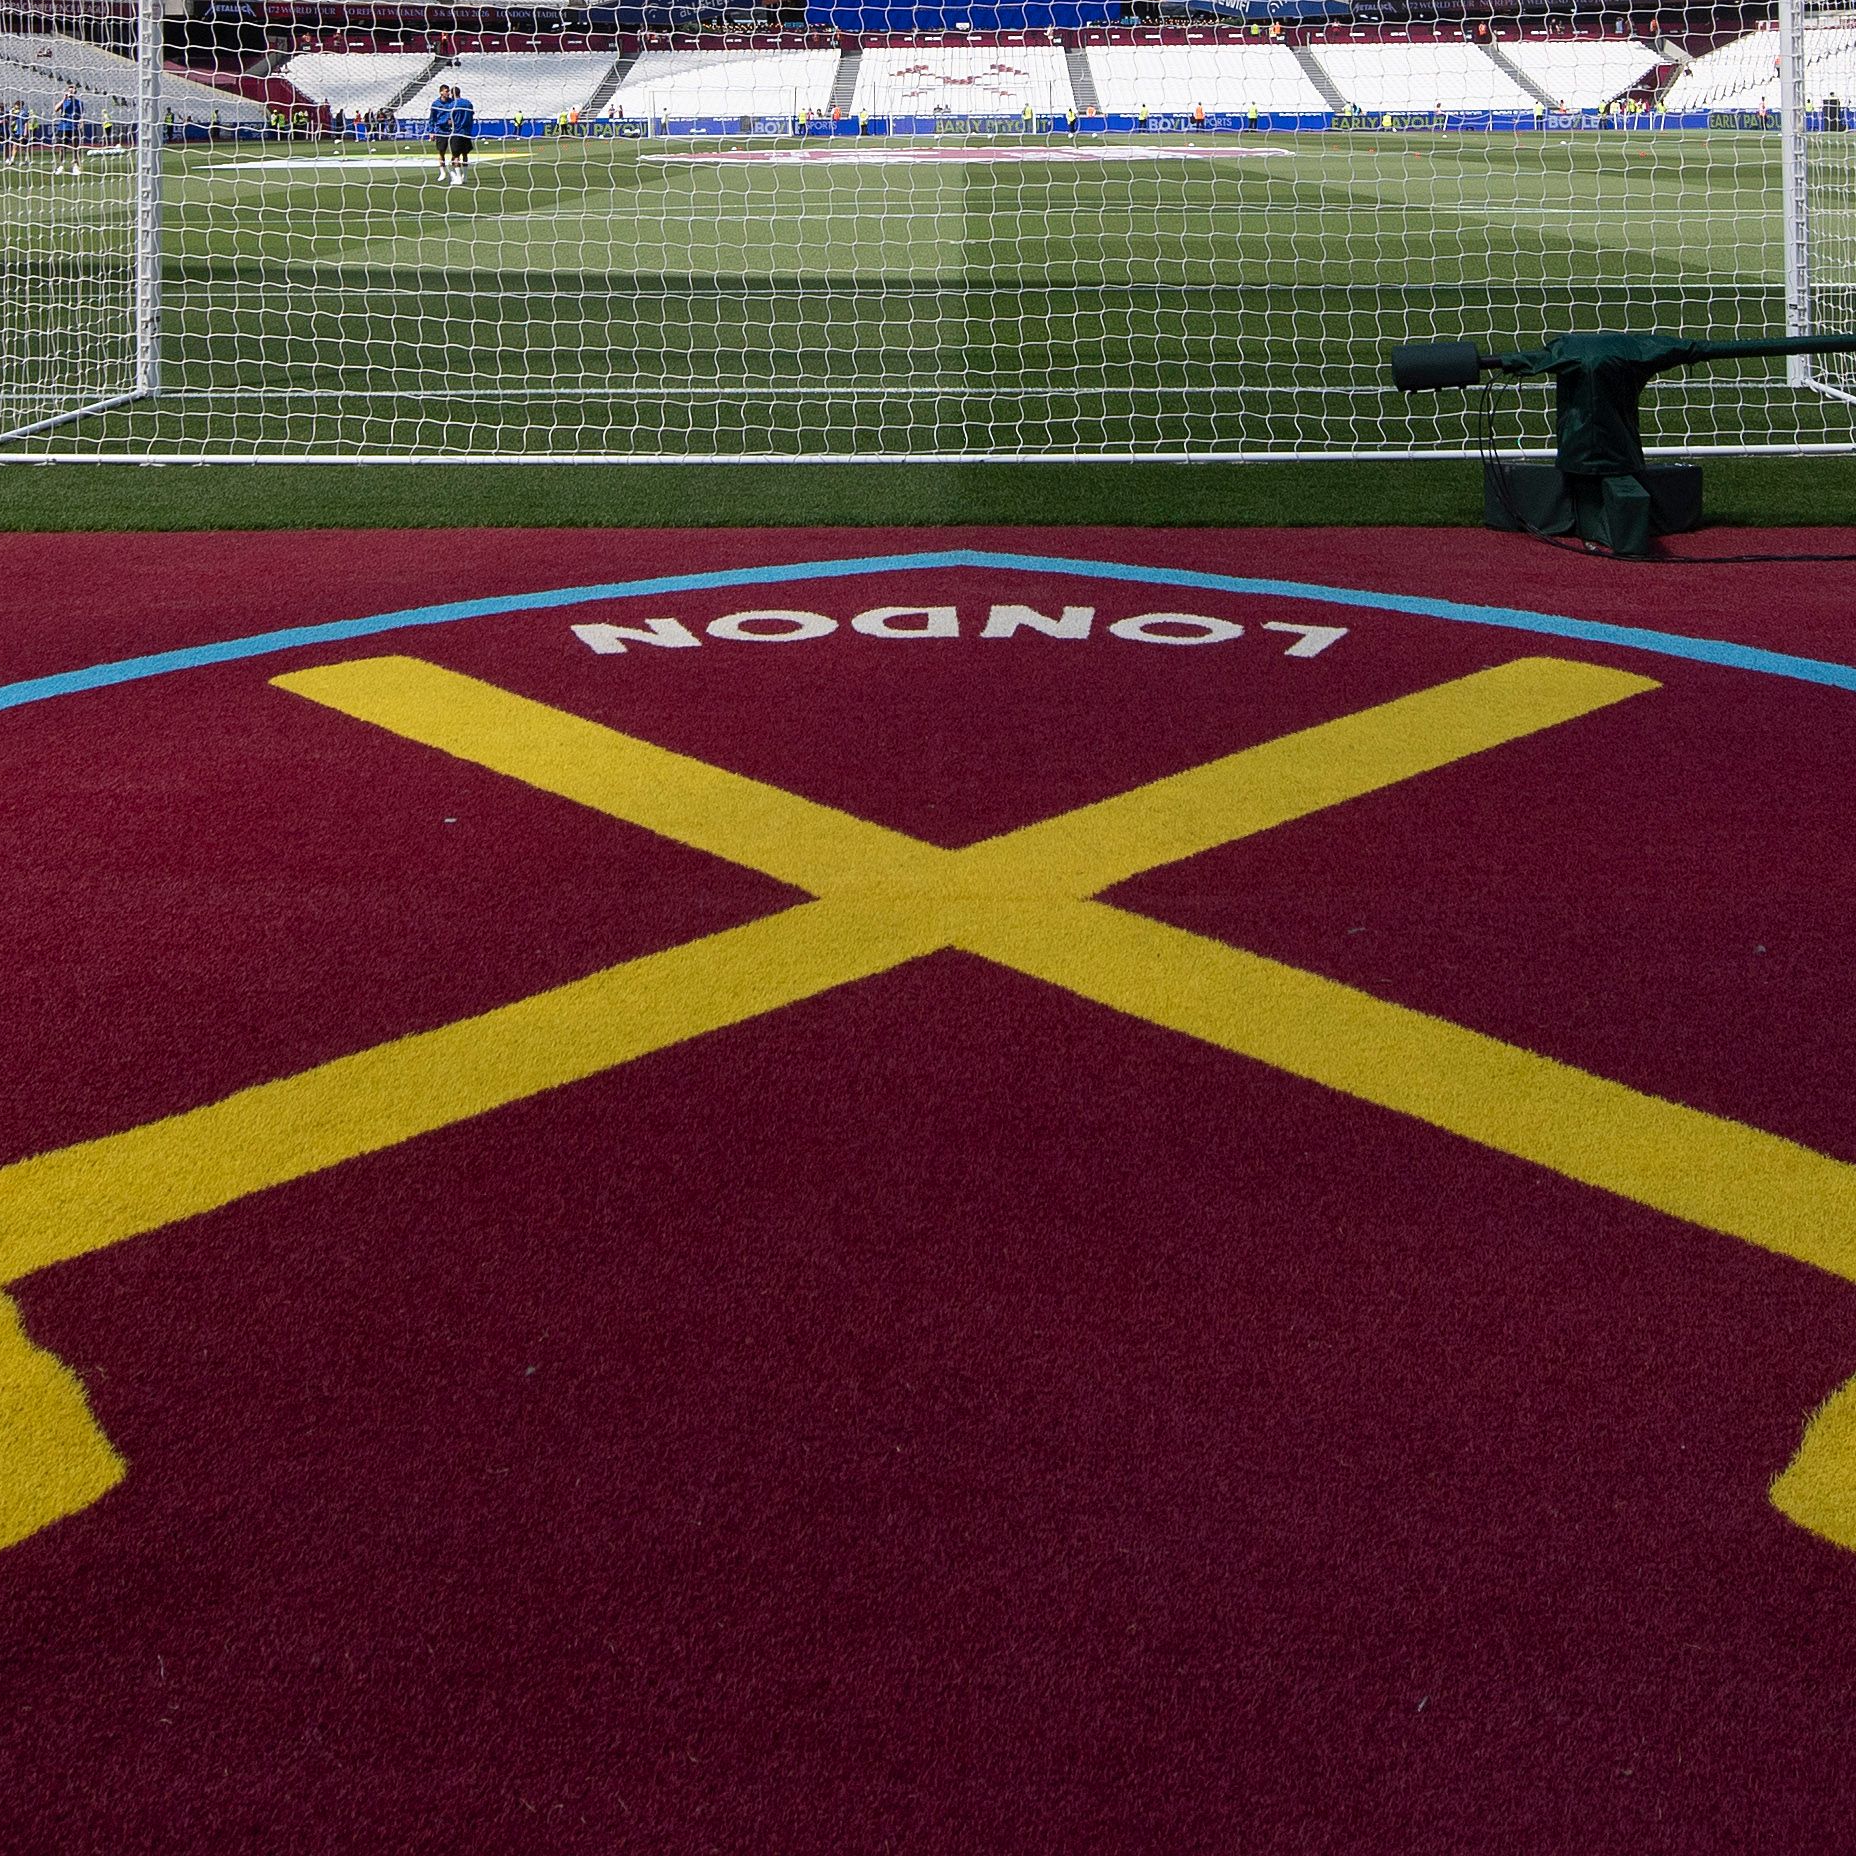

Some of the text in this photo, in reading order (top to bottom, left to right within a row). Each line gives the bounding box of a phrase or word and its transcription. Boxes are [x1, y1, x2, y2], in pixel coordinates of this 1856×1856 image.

[1204, 117, 1233, 128] PORTS
[1331, 117, 1378, 130] EARLY
[1710, 114, 1742, 129] EARLY
[571, 606, 1349, 658] LONDON
